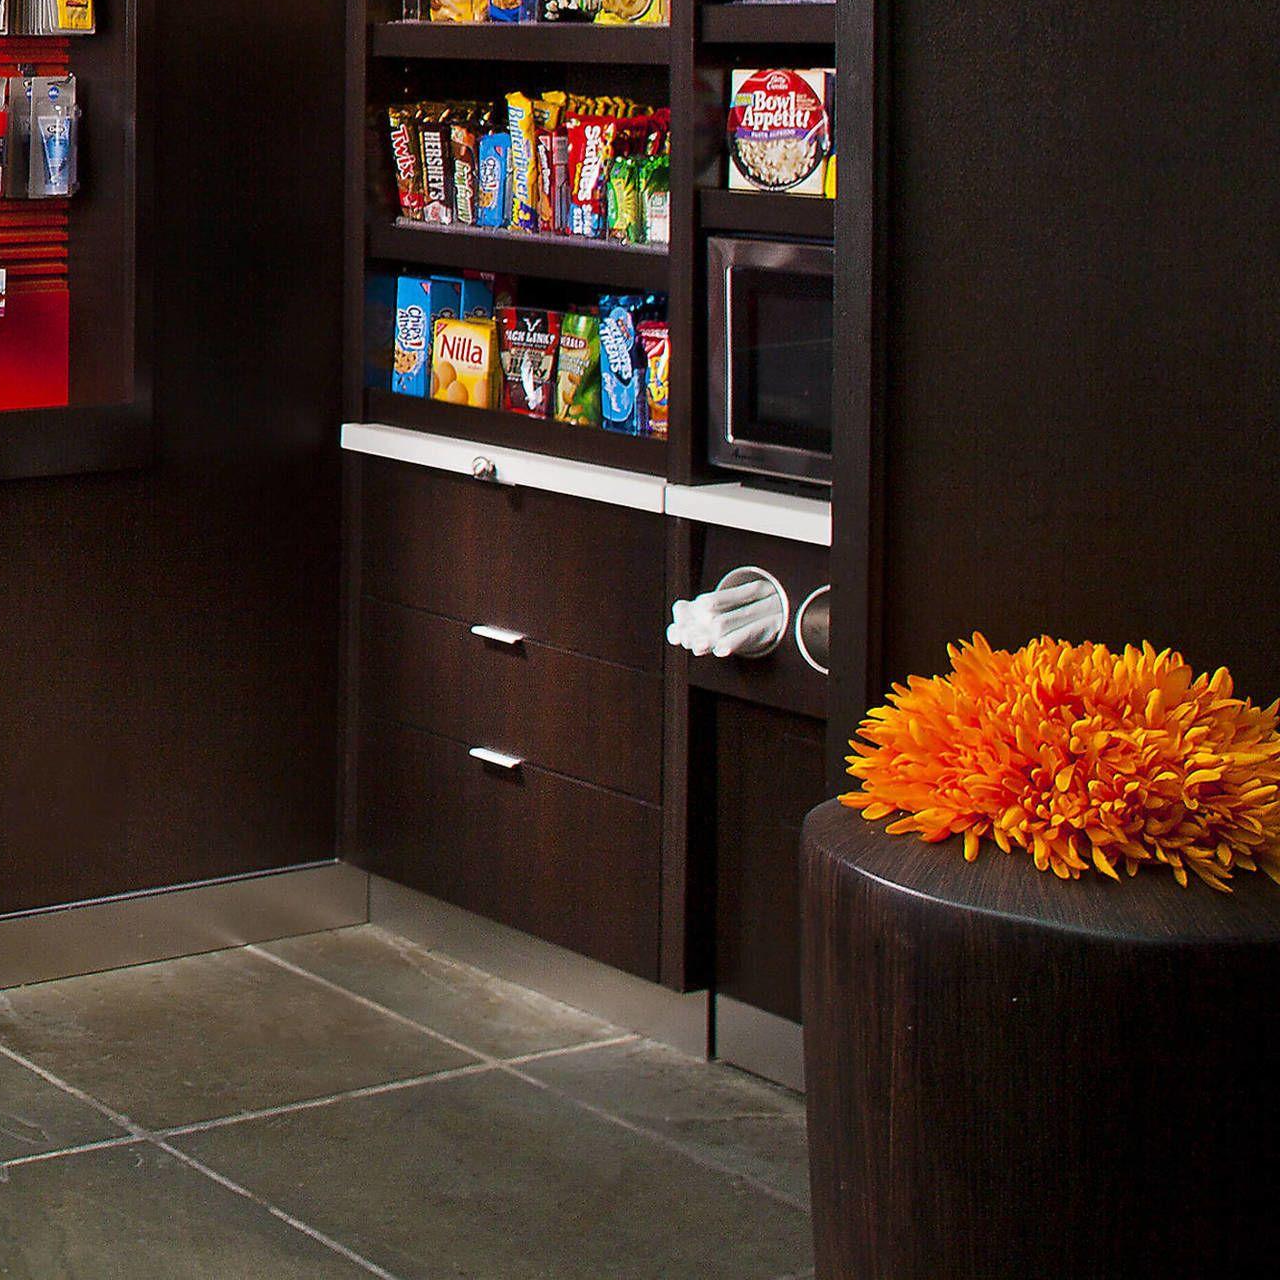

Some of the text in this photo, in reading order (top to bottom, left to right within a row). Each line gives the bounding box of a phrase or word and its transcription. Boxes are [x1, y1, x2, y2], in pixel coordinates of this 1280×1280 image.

[753, 90, 796, 111] Bowl
[391, 123, 416, 180] Twix
[508, 105, 529, 200] Butterfinger
[578, 124, 601, 202] Skittles
[440, 334, 483, 365] Nilla
[598, 323, 620, 373] TREATS
